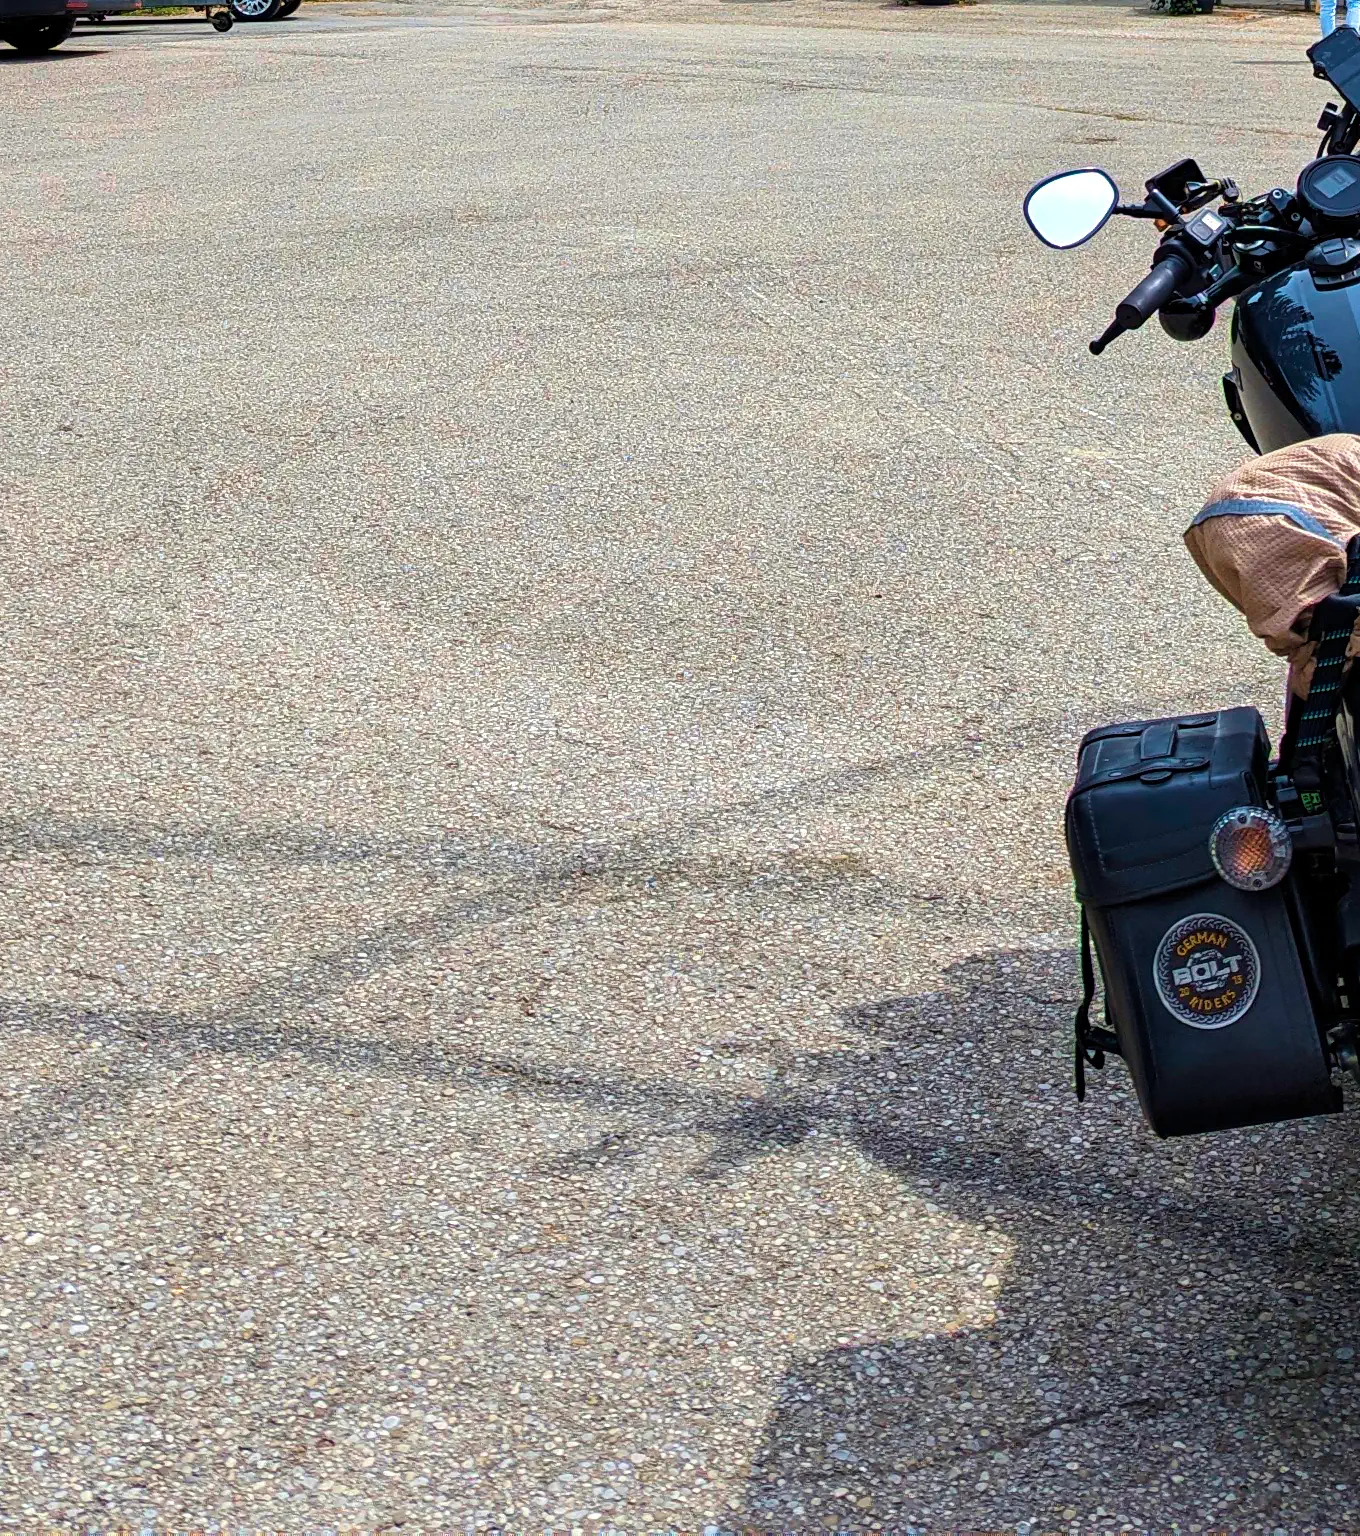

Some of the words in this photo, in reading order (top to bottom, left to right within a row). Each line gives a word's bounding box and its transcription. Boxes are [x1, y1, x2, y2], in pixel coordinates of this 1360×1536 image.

[1176, 931, 1228, 957] GERMAN
[1172, 955, 1242, 986] BOLT
[1189, 989, 1237, 1011] RIDERS
